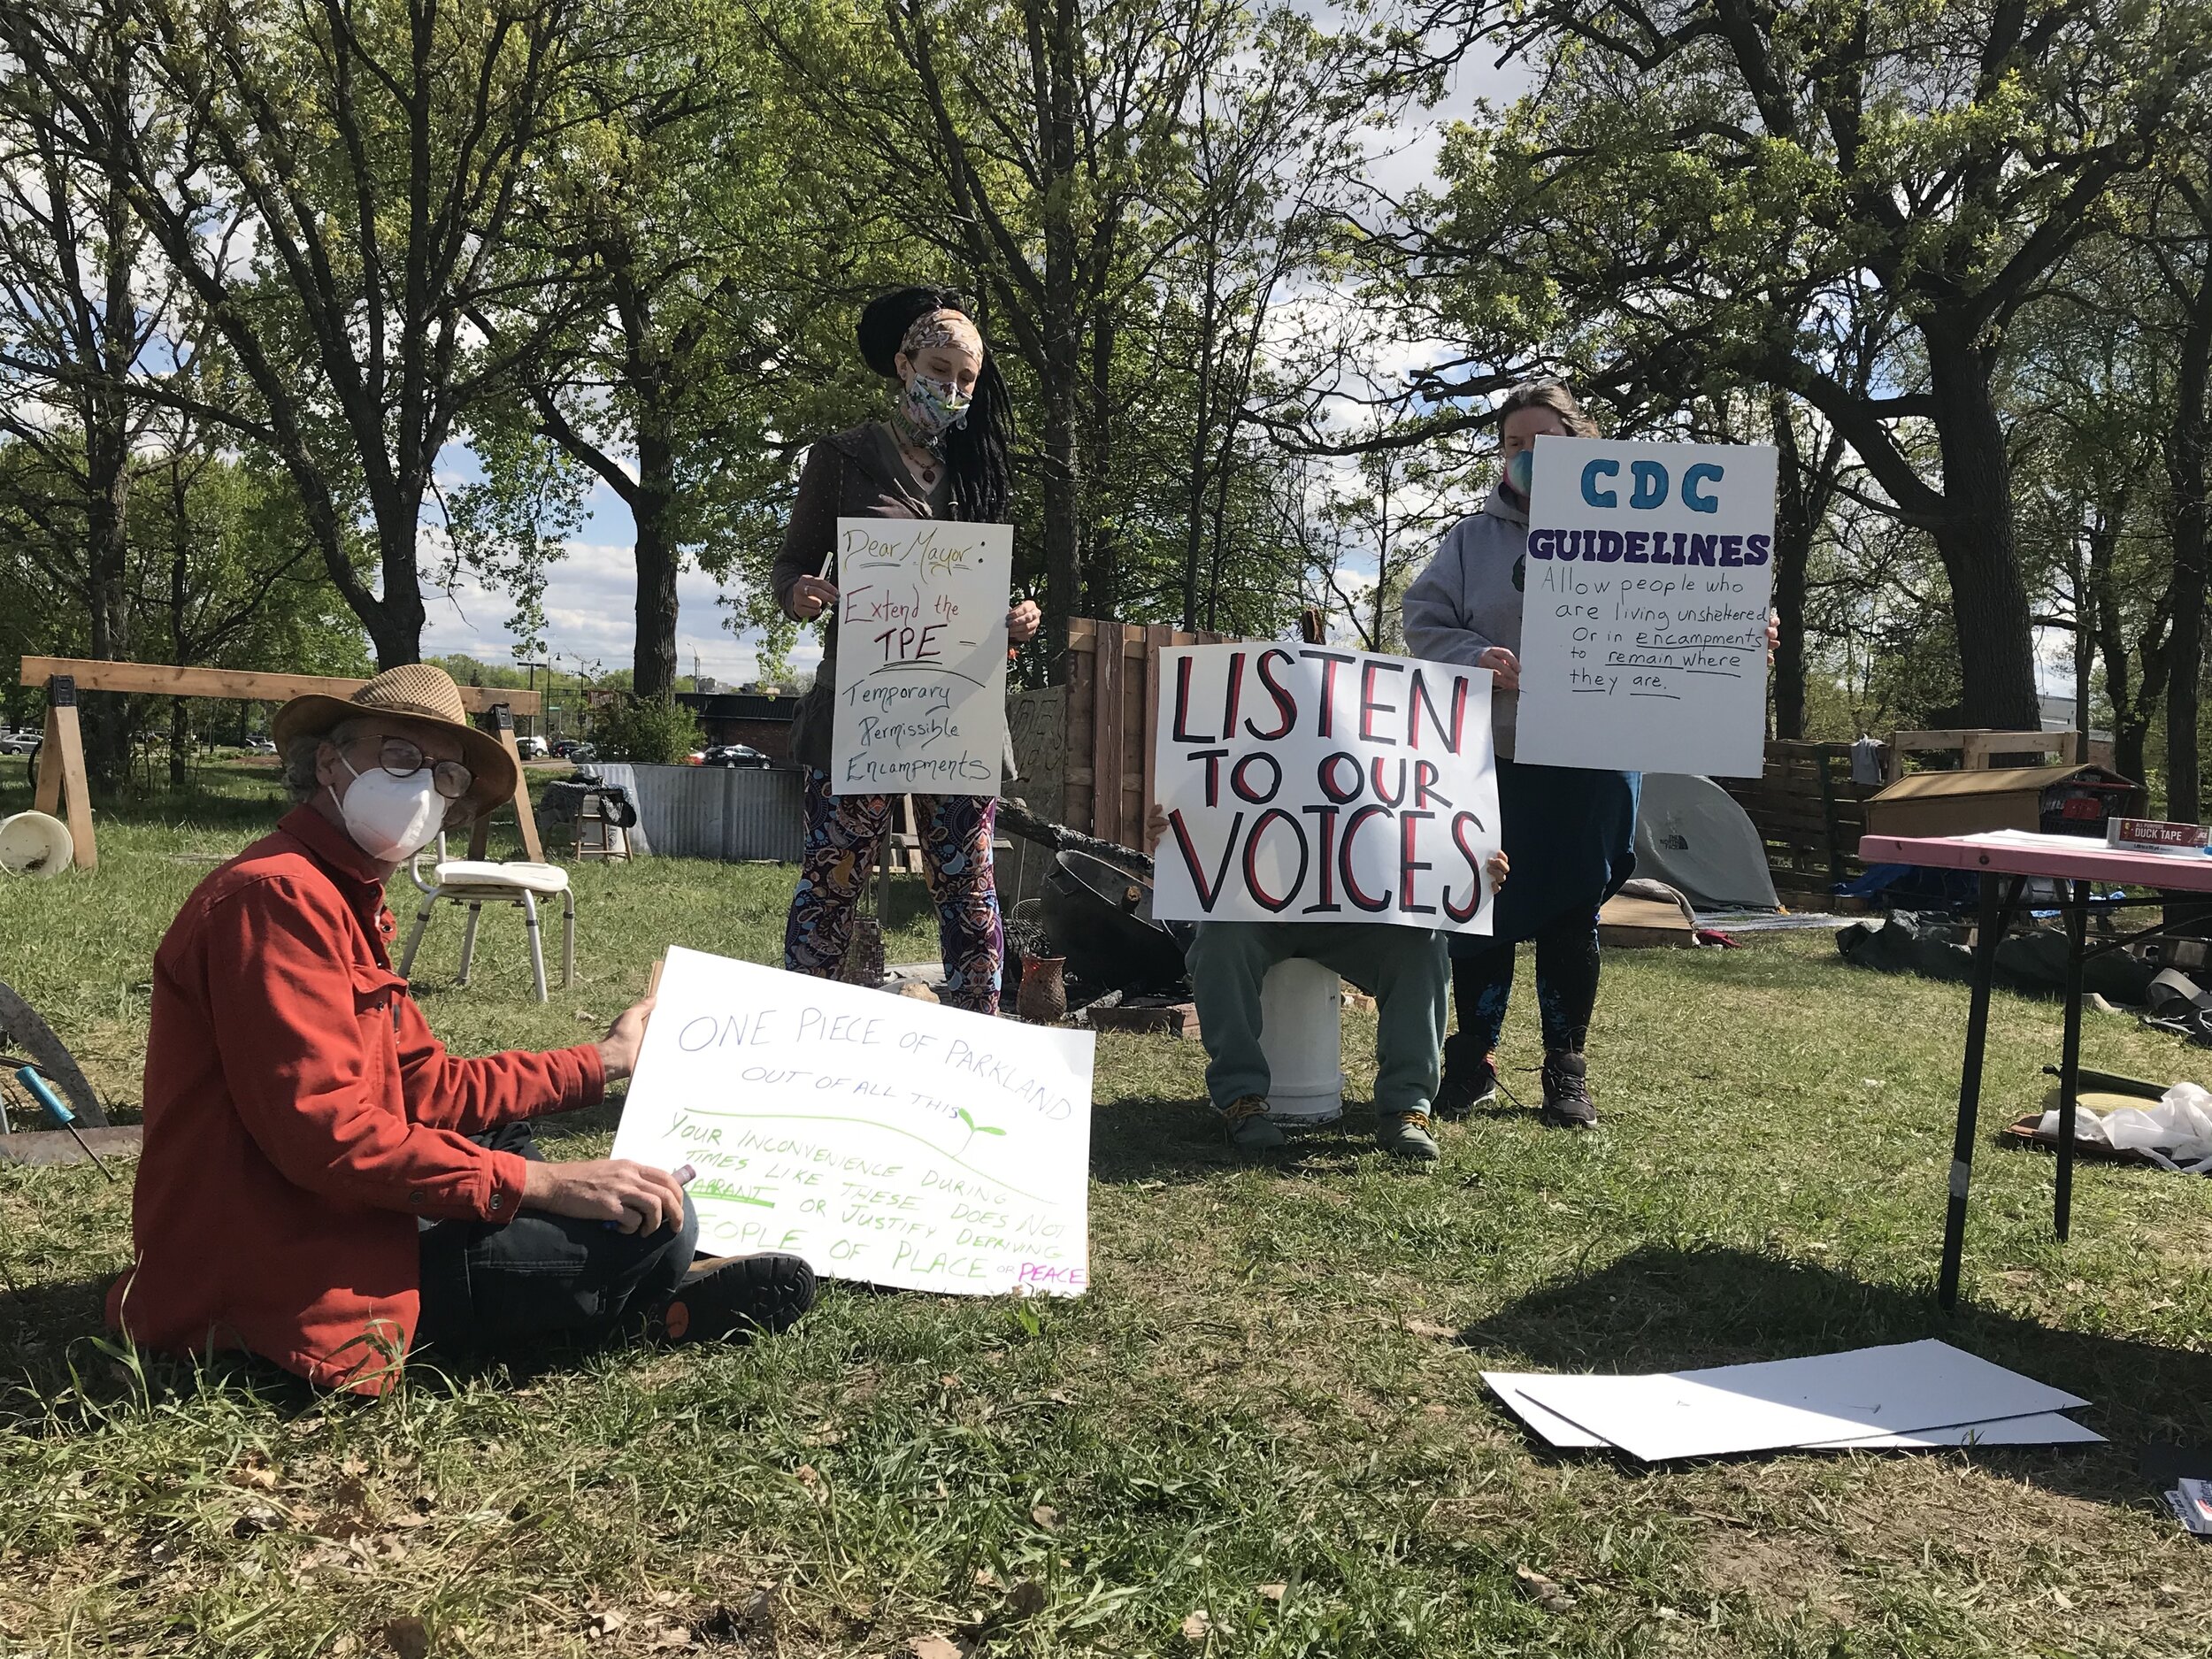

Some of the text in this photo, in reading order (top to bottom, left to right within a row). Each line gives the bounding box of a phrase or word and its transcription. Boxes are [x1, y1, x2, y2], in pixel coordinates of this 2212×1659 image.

[1580, 458, 1724, 514] CDC
[842, 529, 902, 573] Dear
[1527, 528, 1771, 567] GUIDELINES
[844, 583, 959, 627] Extend the
[1541, 565, 1744, 605] Allow people who
[1555, 603, 1769, 631] are living unsheltered
[1572, 626, 1763, 650] Or in encampments
[873, 624, 948, 662] TPE
[1571, 646, 1741, 667] to remain where
[842, 680, 951, 717] Temporary
[1172, 648, 1469, 757] LISTEN
[1570, 667, 1667, 695] they are.
[858, 717, 960, 750] Permissible
[847, 749, 991, 782] Encampments
[1187, 749, 1454, 810] TO OUR
[2134, 827, 2158, 839] DUCK
[2160, 829, 2183, 841] TAPE
[1168, 803, 1486, 925] VOICES
[679, 1007, 1071, 1120] ONE PIECE OF PARKLAND
[741, 1067, 959, 1118] OUT OF ALL THIS
[662, 1111, 1007, 1204] YOUR INCONVENIENCE DURING
[687, 1149, 1071, 1238] TIMES LIKE THESE DOES NOT
[678, 1175, 1064, 1259] ARRANT OR JUSTIFY DEPRIVING
[696, 1213, 1087, 1284] EOPLE OF PLACE OR PEACE
